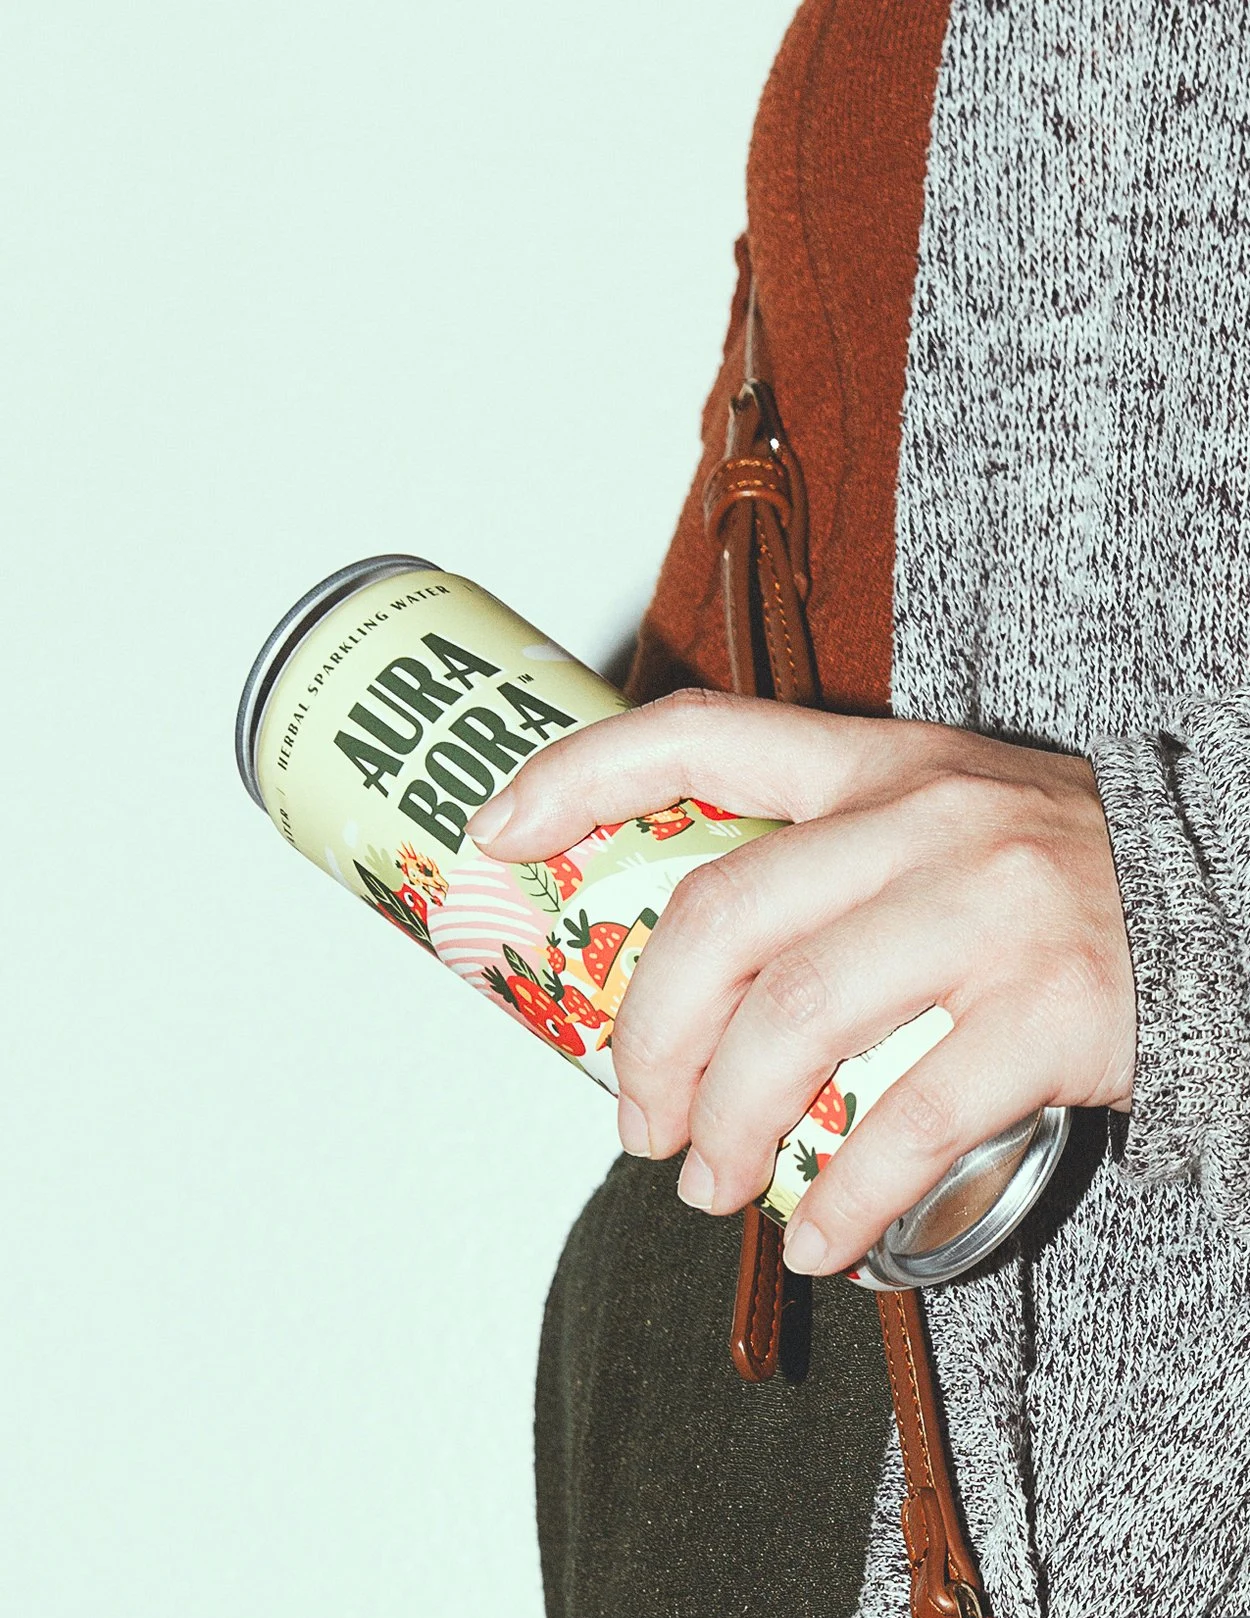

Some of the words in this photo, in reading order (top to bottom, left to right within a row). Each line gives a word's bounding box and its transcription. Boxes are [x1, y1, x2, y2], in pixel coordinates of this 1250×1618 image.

[277, 702, 310, 771] HERBAL
[307, 610, 389, 697] SPARKLING
[390, 585, 451, 611] WATER
[333, 632, 502, 798] AURA
[398, 681, 579, 855] BORA
